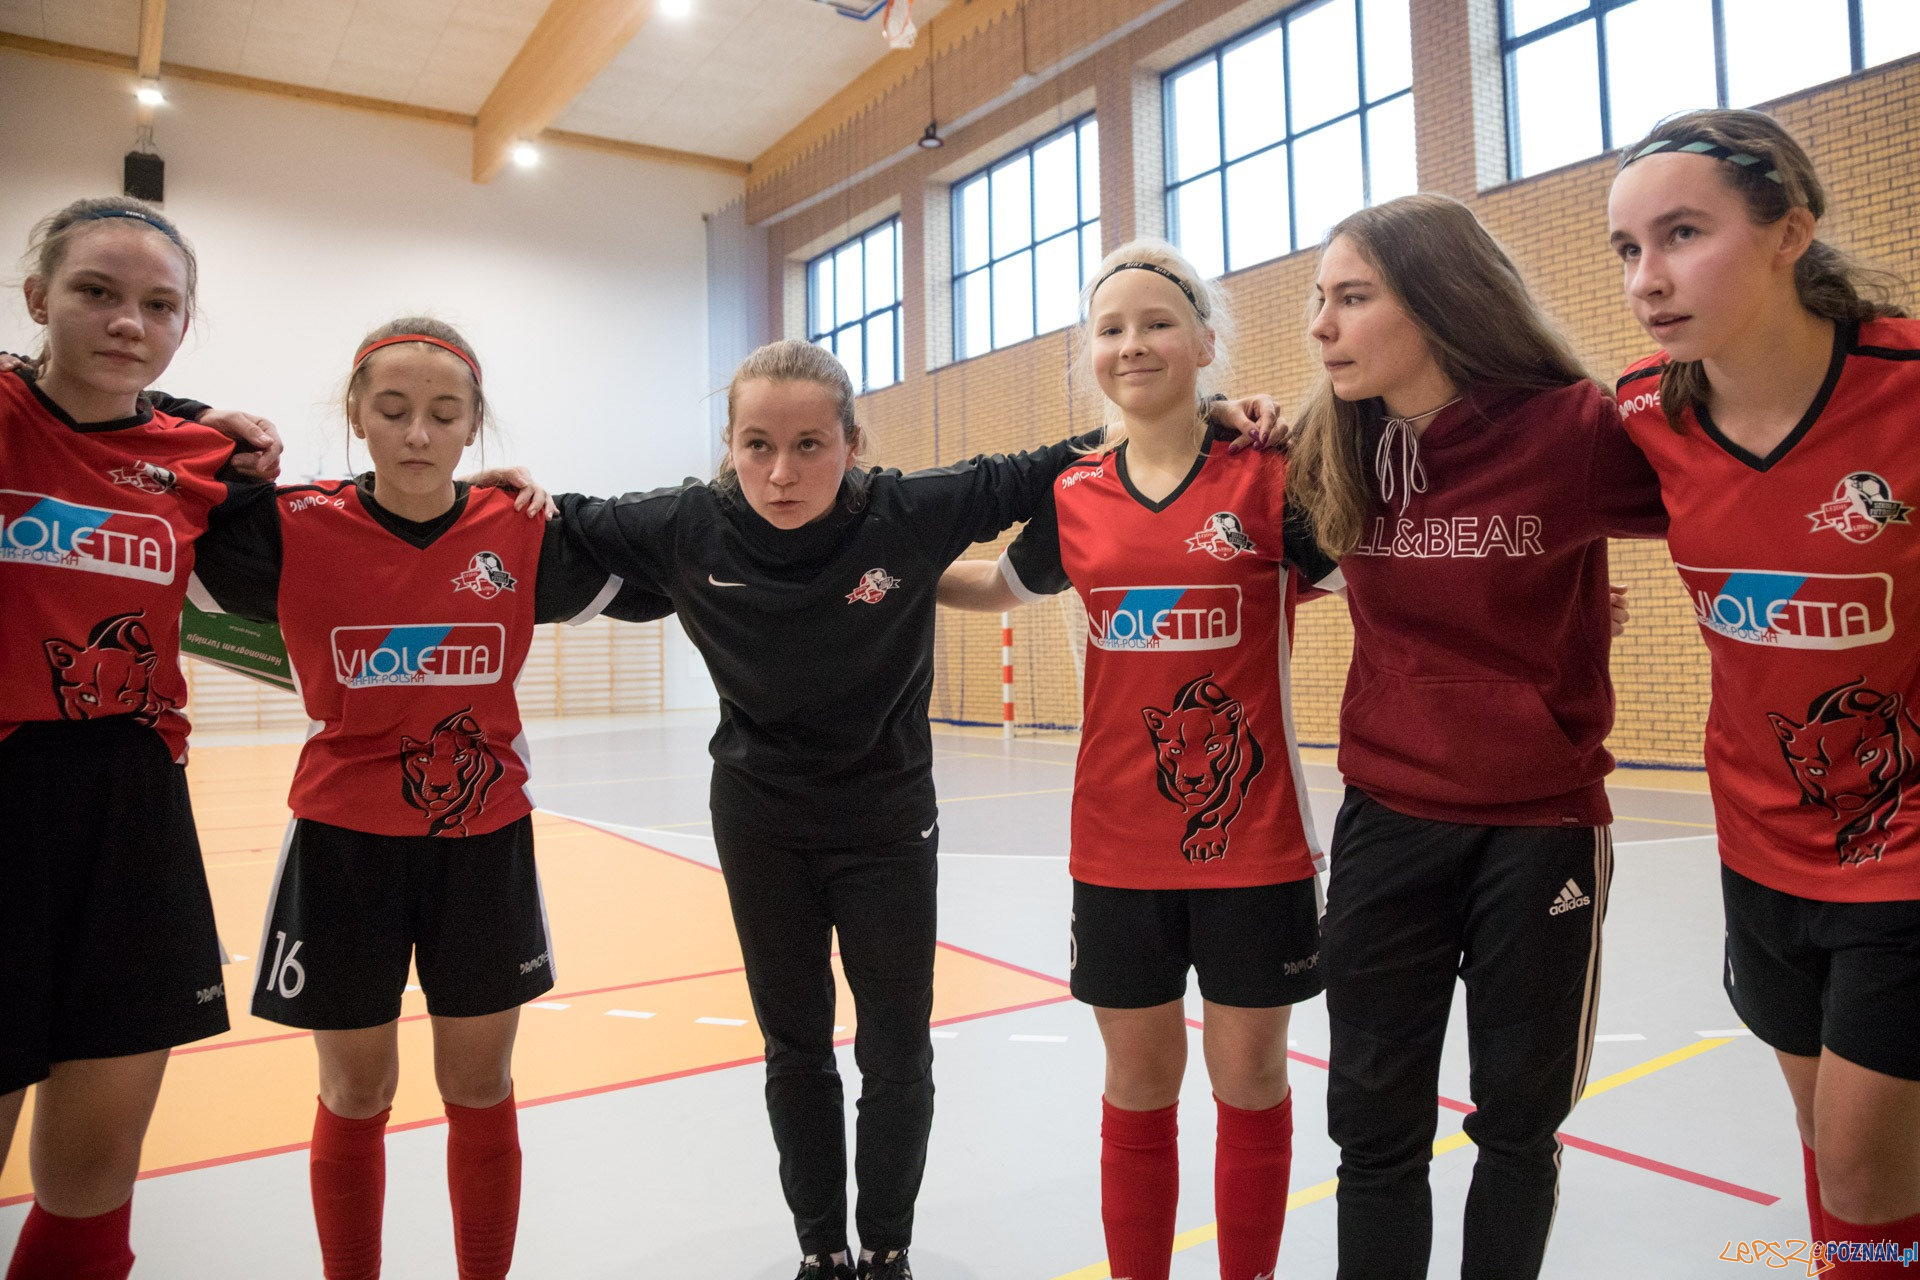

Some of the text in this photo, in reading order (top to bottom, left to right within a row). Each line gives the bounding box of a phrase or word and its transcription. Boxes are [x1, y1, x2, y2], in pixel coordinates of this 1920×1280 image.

[1124, 261, 1145, 269] NIKE
[1153, 265, 1172, 277] NIKE
[0, 514, 161, 572] IOLETTA
[1088, 607, 1227, 640] VIOLETTA
[1692, 589, 1871, 638] VIOLETTA
[185, 633, 282, 667] Harmonogram turnieju
[337, 645, 490, 676] VIOLETTA
[1549, 896, 1591, 916] adidas
[266, 930, 306, 999] 16
